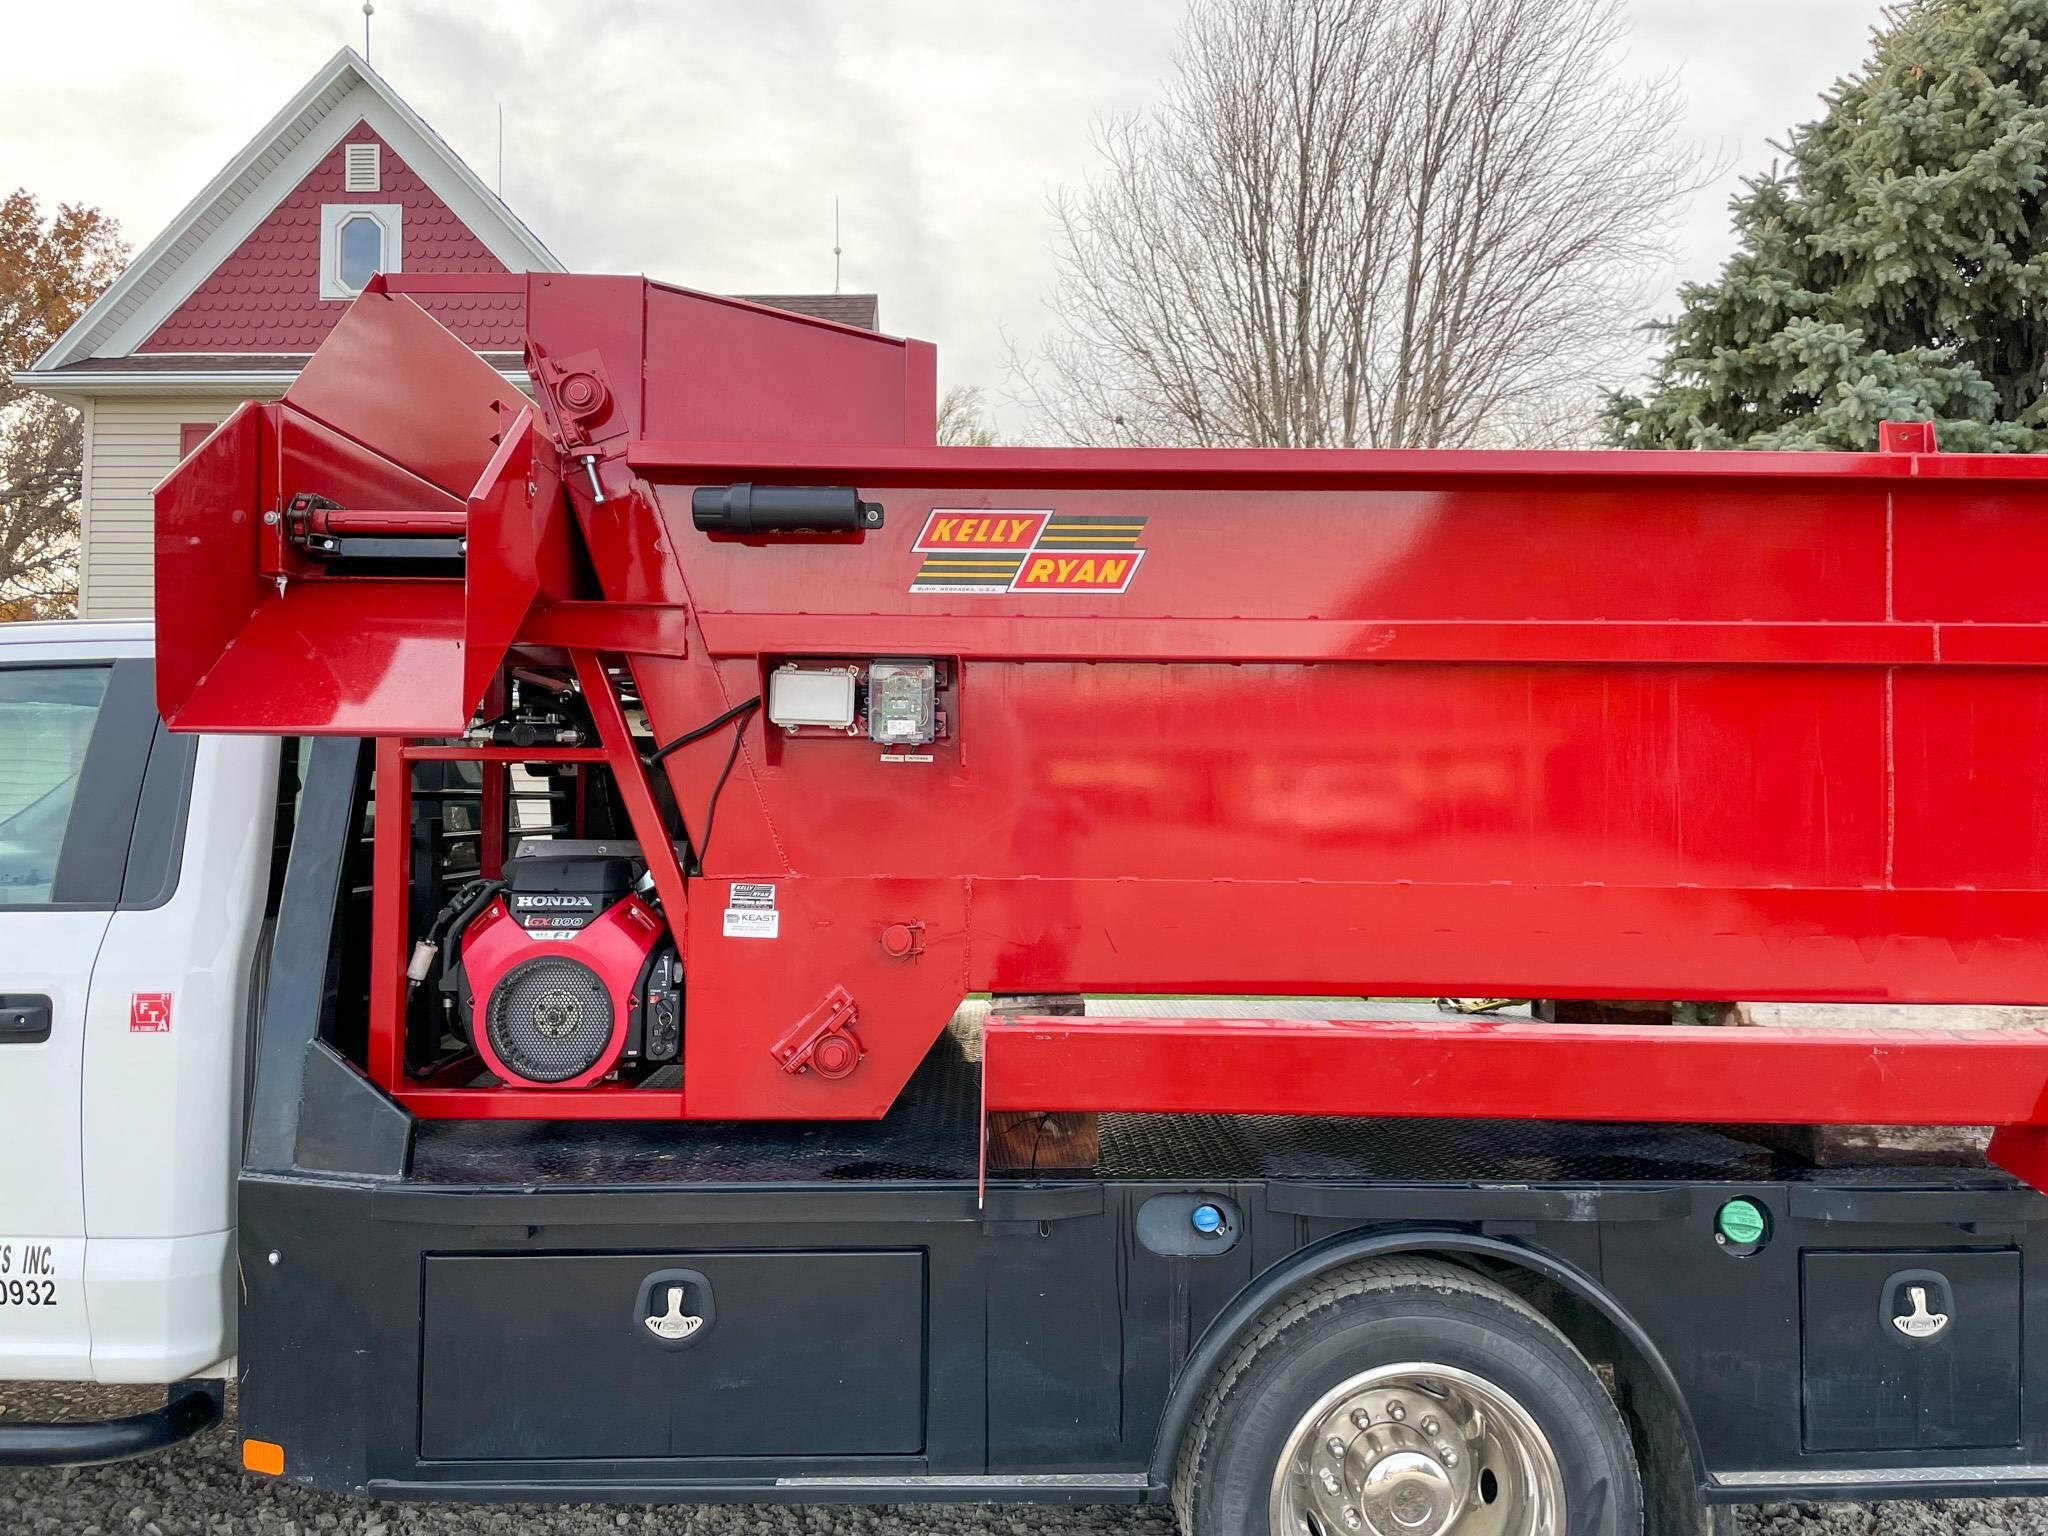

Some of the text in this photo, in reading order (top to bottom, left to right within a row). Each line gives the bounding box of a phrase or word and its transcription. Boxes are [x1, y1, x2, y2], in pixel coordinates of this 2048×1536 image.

[930, 518, 1033, 543] KELLY
[1025, 558, 1128, 584] RYAN
[516, 896, 592, 907] HONDA
[741, 914, 776, 922] KEAST
[22, 1245, 55, 1275] INC.
